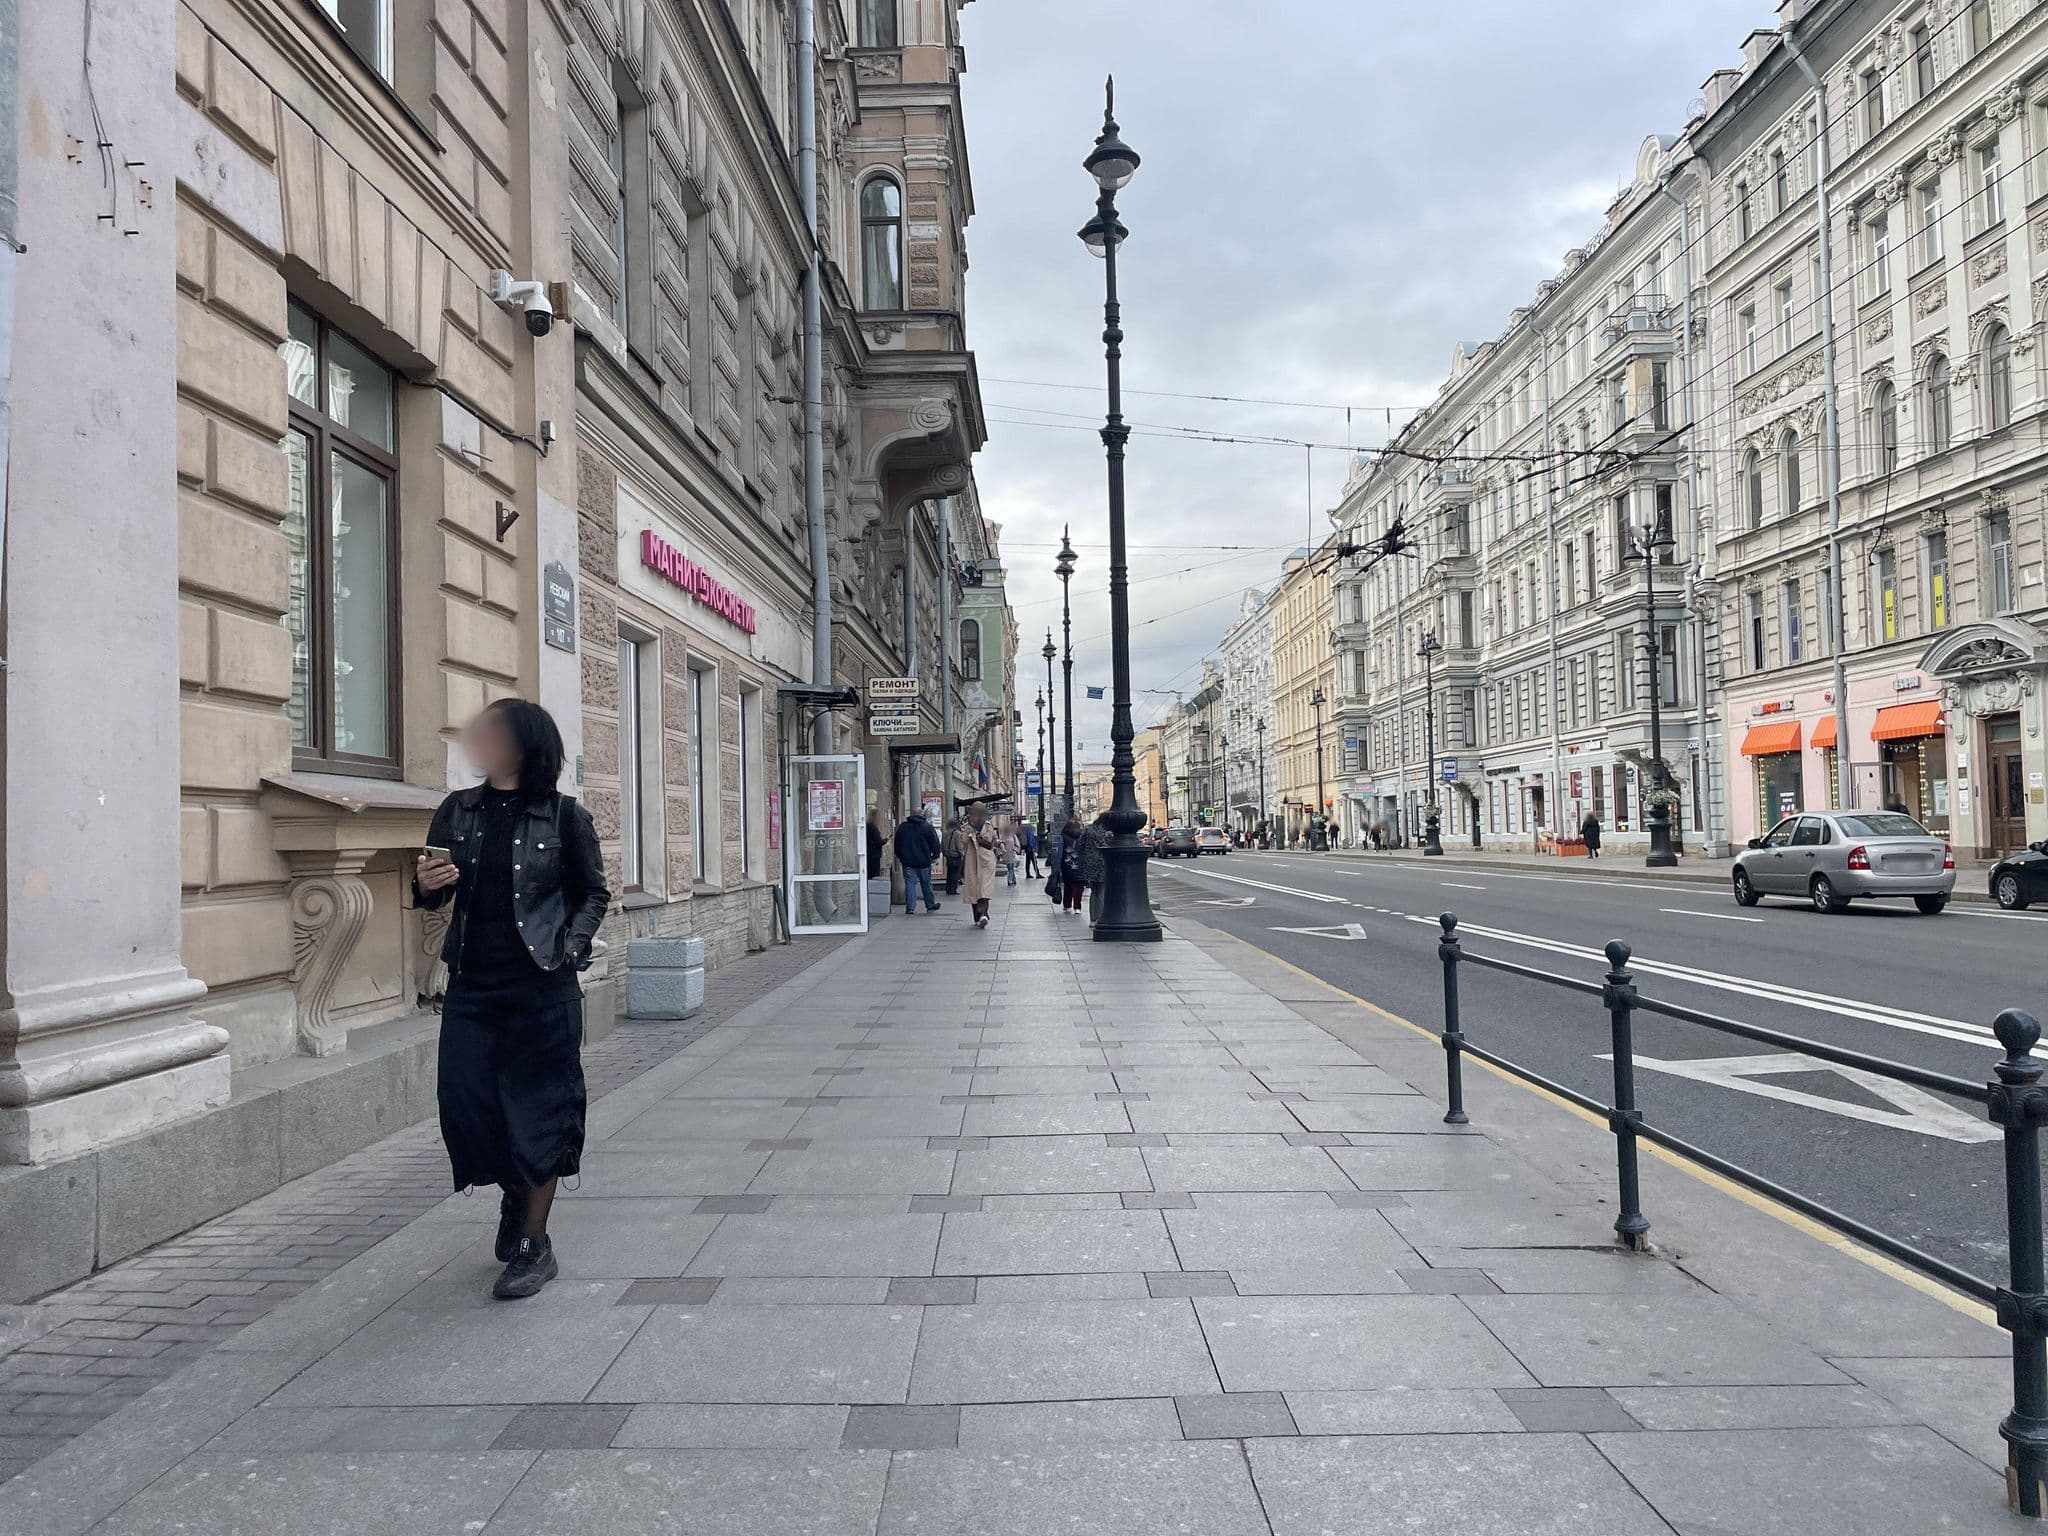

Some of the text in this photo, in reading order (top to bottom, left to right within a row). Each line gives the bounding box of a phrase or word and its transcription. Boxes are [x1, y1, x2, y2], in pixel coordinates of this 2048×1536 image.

[549, 581, 570, 602] НЕВСКИЙ
[644, 530, 757, 635] МАГНИТ КОСМЕТИК
